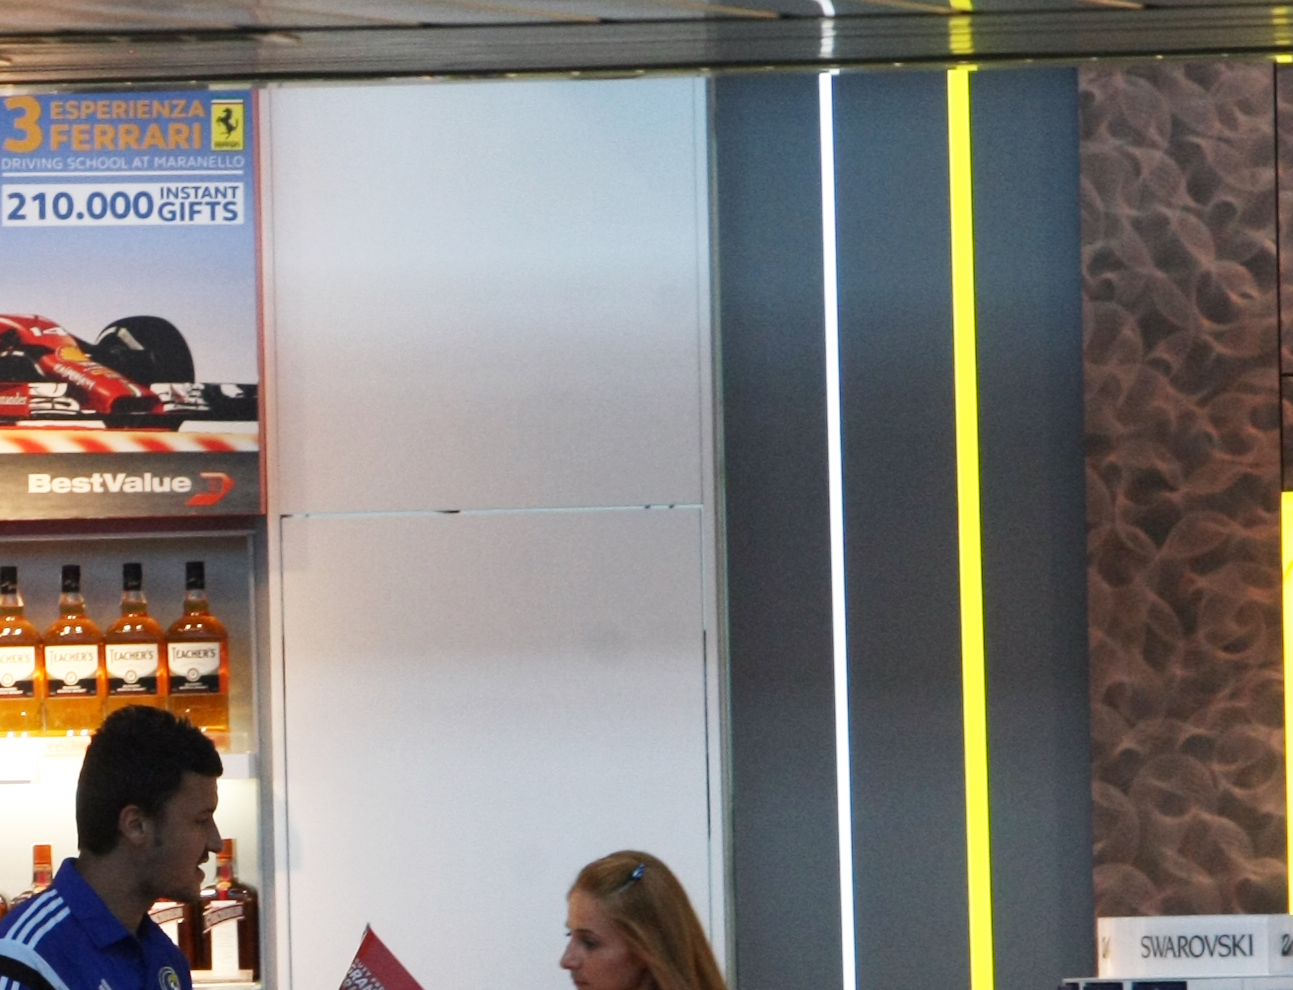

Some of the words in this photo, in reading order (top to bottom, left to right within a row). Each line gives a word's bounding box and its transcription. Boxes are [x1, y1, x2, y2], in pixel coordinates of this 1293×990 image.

[50, 100, 206, 120] ESPERIENZA
[3, 95, 43, 153] 3
[50, 122, 203, 152] FERRARI
[2, 157, 63, 170] DRIVING
[67, 156, 128, 170] SCHOOL
[132, 156, 150, 169] AT
[154, 155, 245, 169] MARANELLO
[160, 186, 240, 200] INSTANT
[7, 190, 154, 221] 210.000
[158, 201, 239, 222] GIFTS
[27, 473, 192, 494] BestValue
[109, 647, 154, 663] TEACHER'S
[1140, 934, 1254, 958] SWAROVSKI
